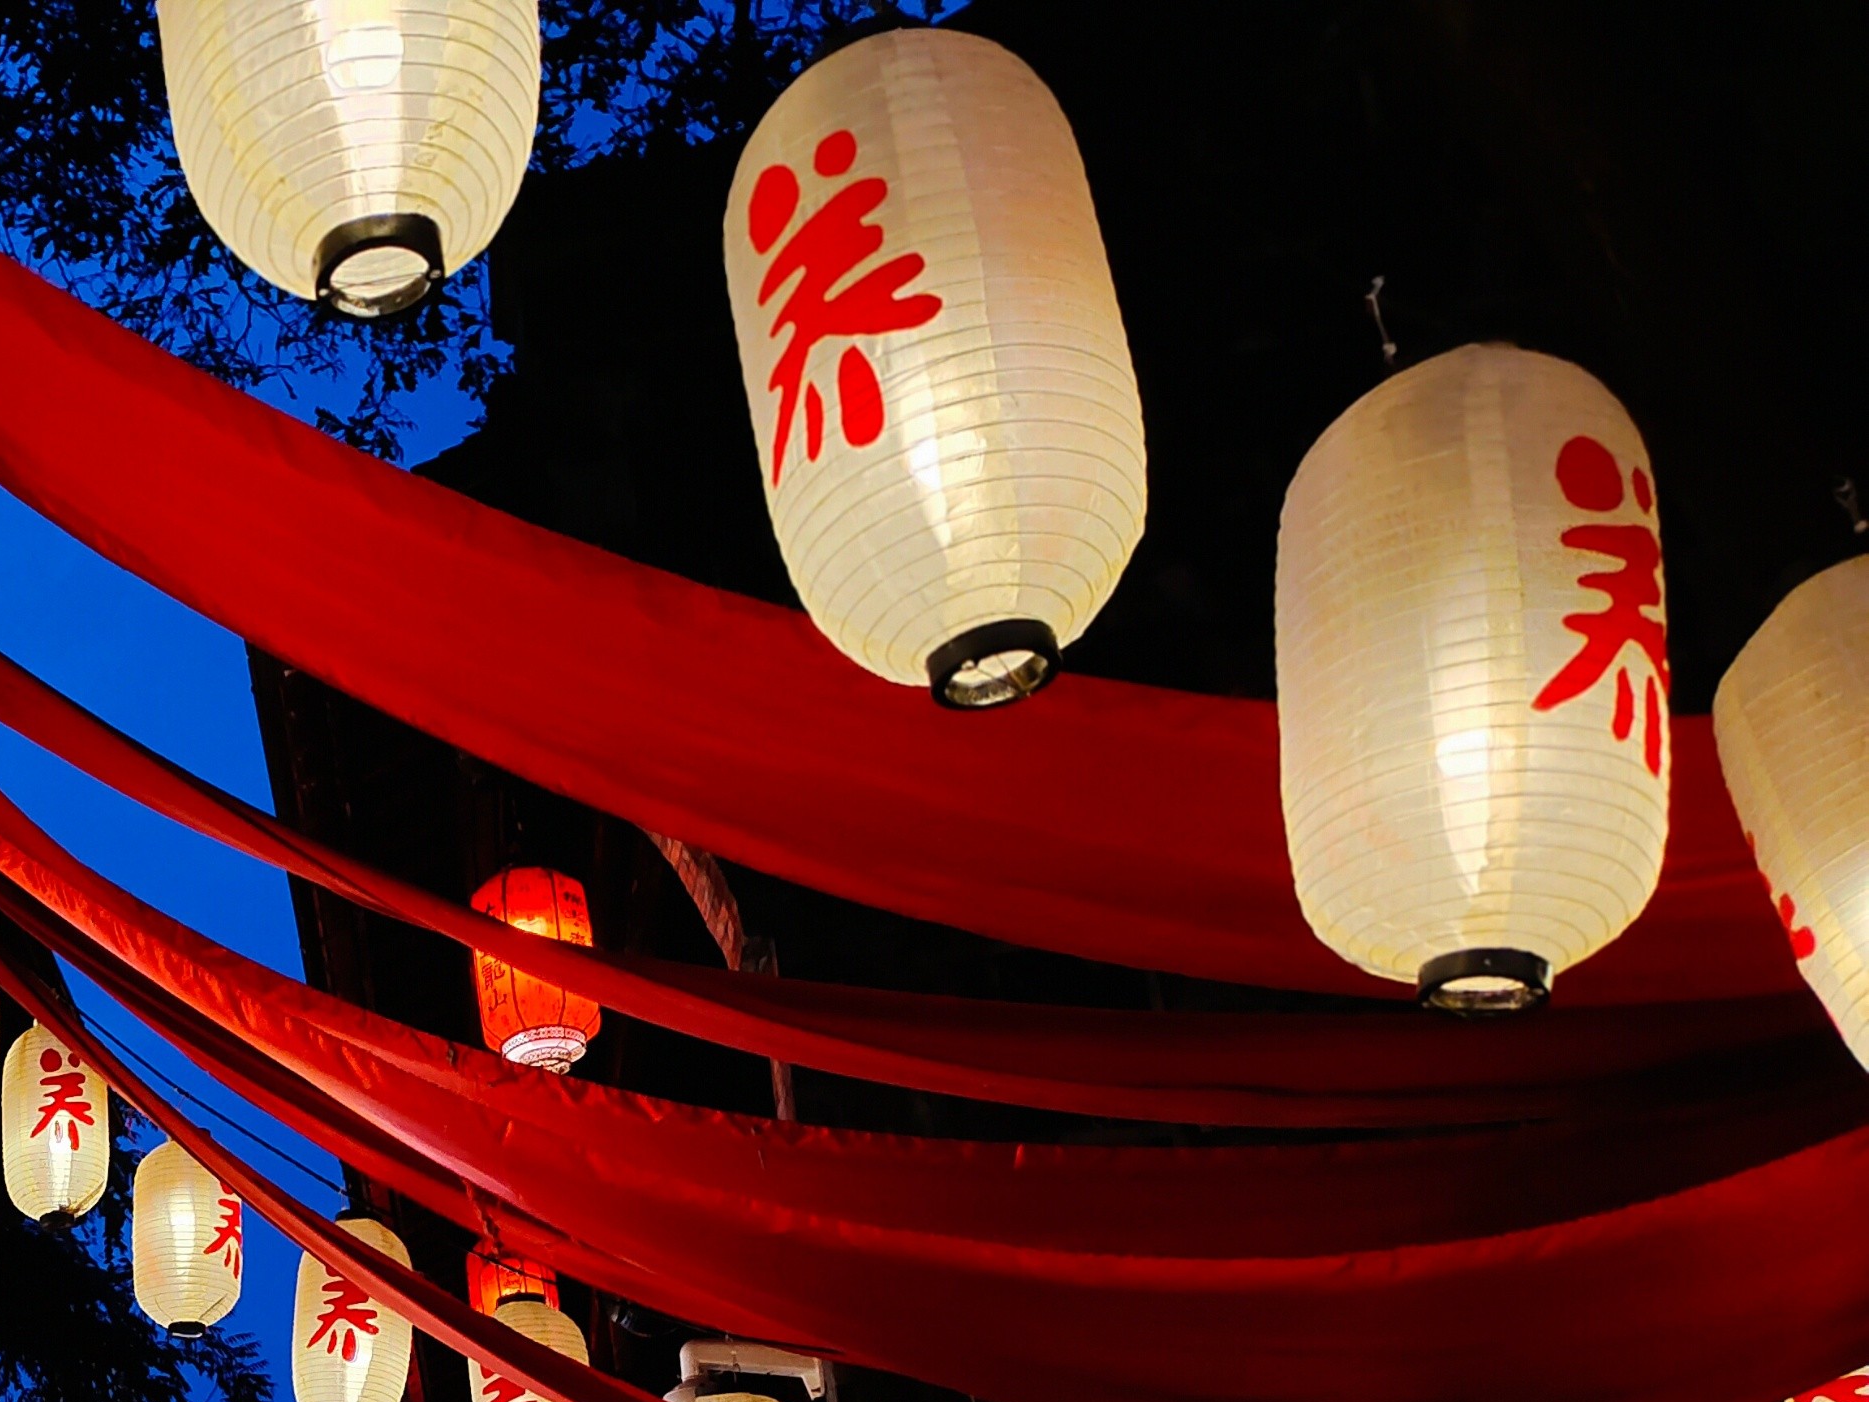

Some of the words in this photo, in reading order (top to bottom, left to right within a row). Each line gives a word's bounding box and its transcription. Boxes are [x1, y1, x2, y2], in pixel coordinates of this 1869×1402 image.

[748, 129, 942, 487] 养
[1532, 436, 1670, 777] 养
[30, 1048, 95, 1151] 养
